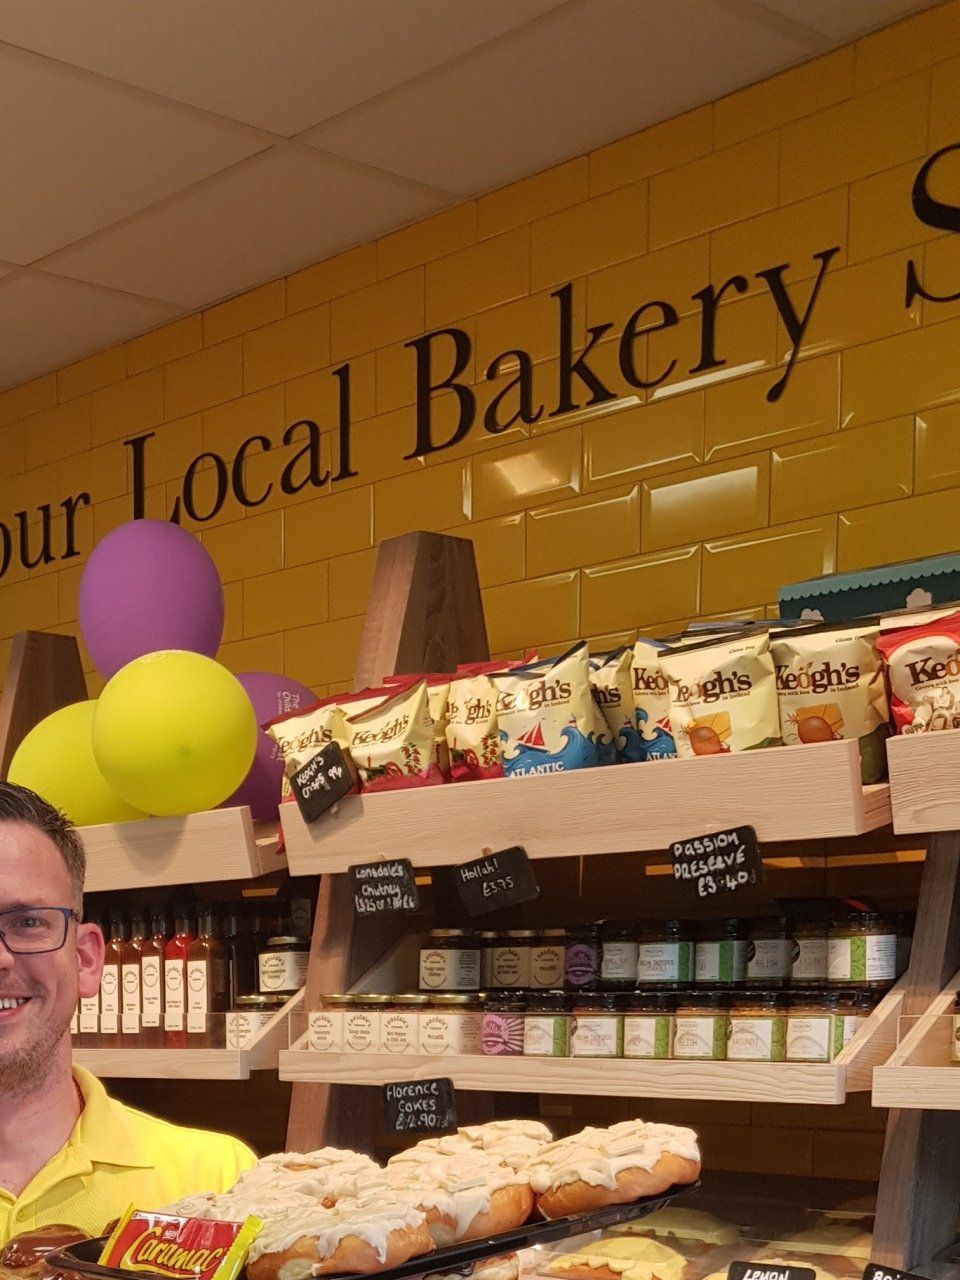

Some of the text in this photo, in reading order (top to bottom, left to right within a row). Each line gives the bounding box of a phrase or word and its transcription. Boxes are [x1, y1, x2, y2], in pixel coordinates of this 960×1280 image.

[123, 363, 359, 526] Local
[402, 245, 841, 463] Bakery
[509, 761, 565, 777] ATLANTIC
[120, 1226, 224, 1278] Caramac
